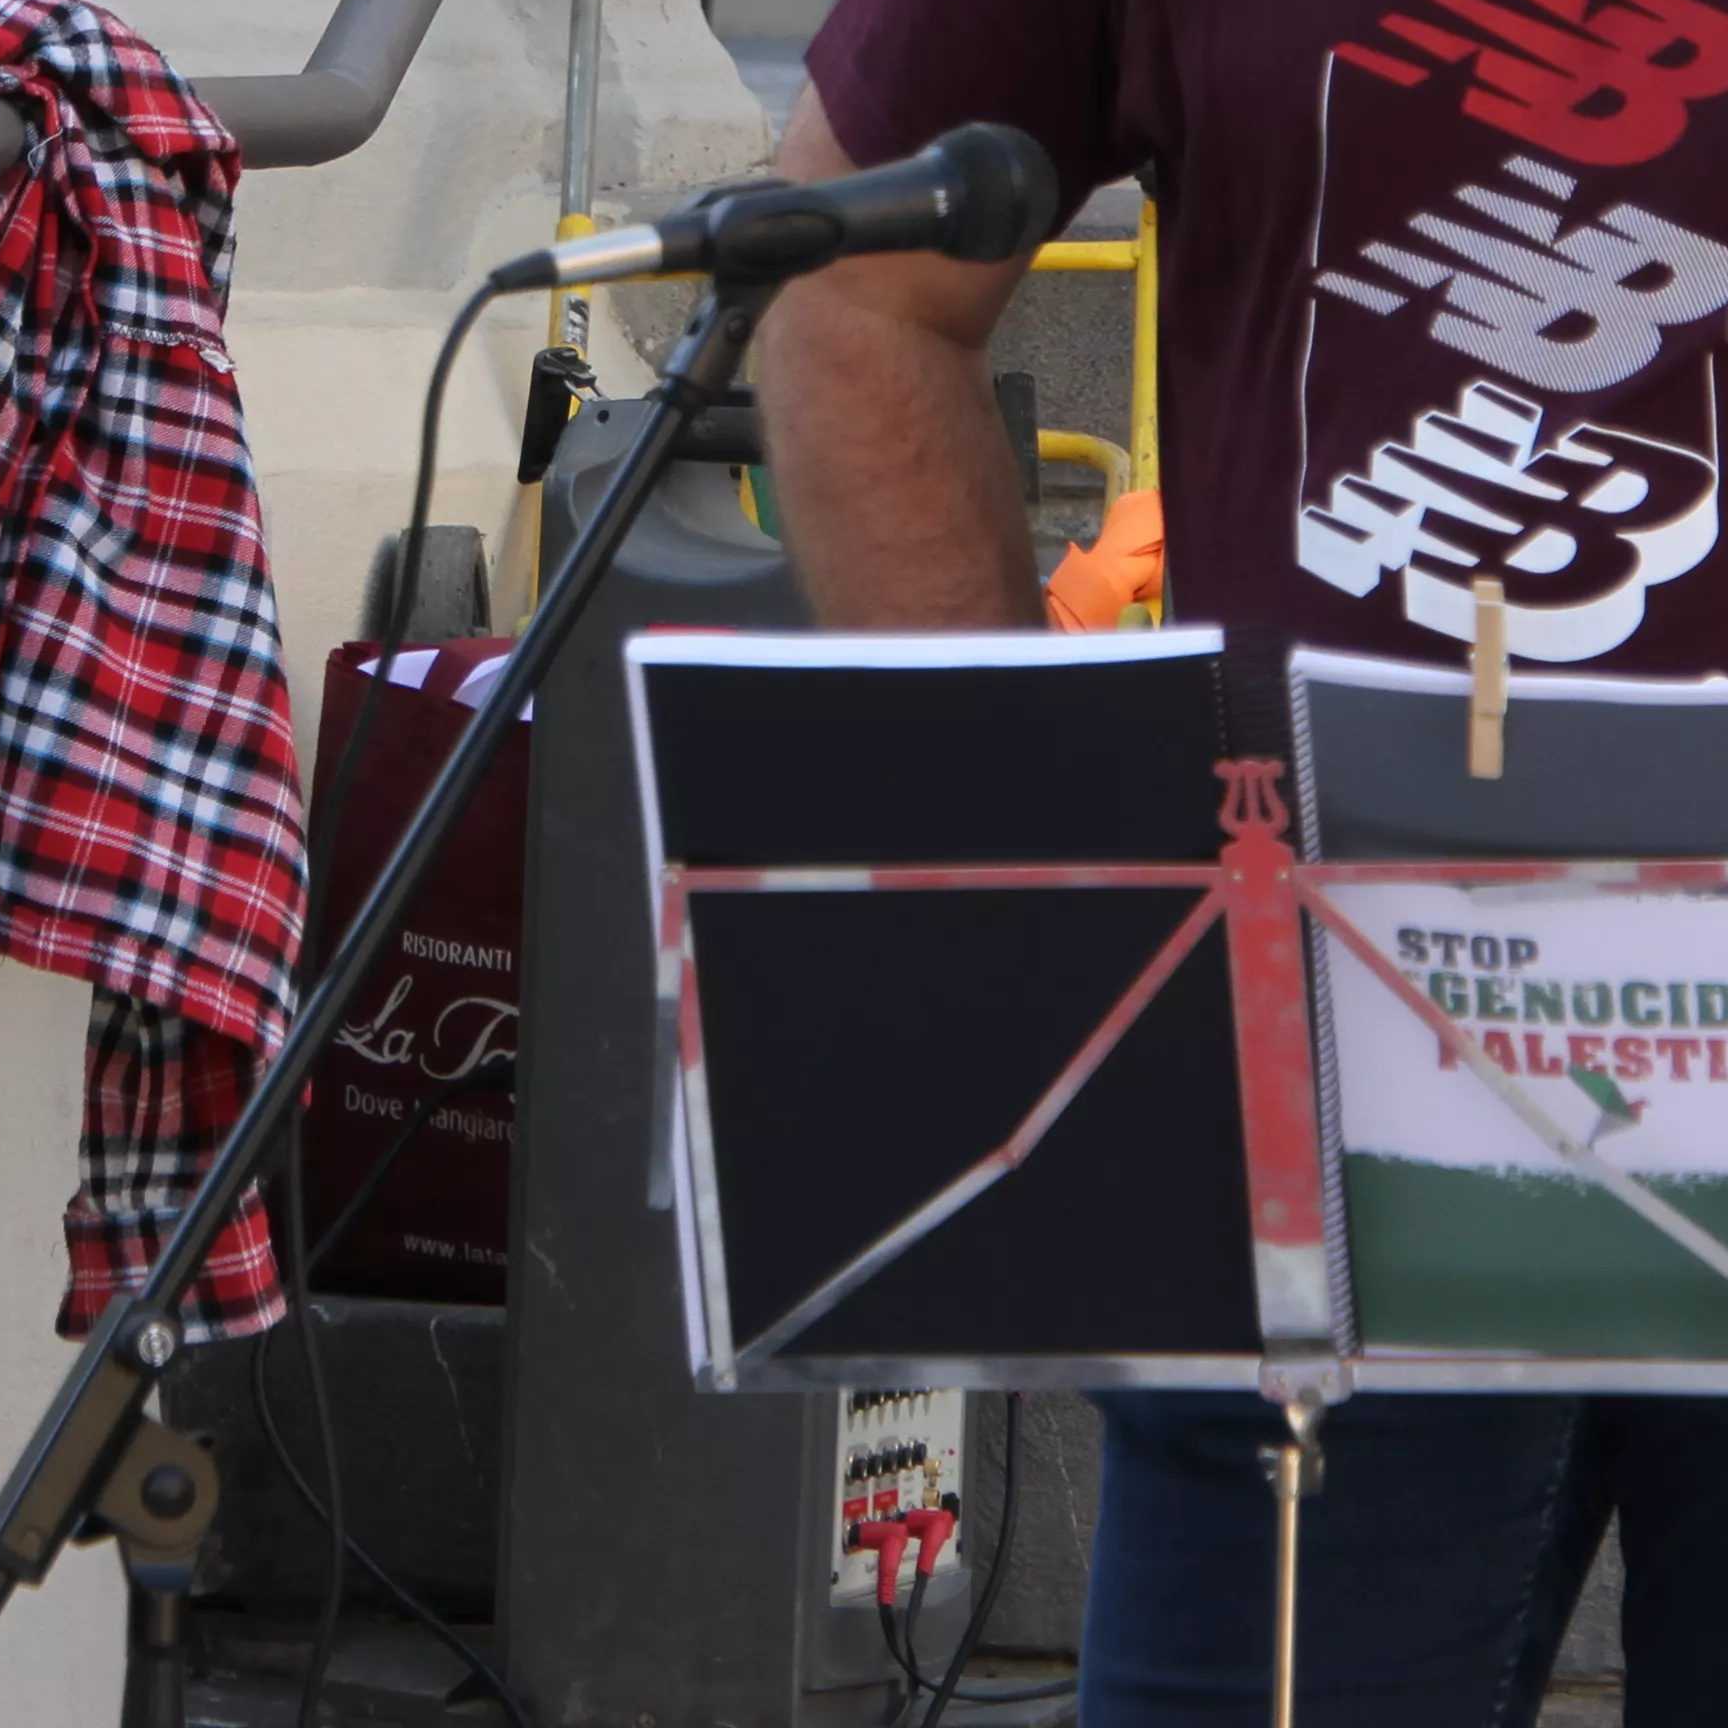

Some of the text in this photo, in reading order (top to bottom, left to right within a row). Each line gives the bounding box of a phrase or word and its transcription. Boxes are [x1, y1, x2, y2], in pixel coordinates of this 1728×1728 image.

[403, 931, 512, 972] RISTORANTI
[1397, 927, 1539, 970] STOP
[333, 974, 416, 1064] La
[345, 1085, 403, 1121] Dove
